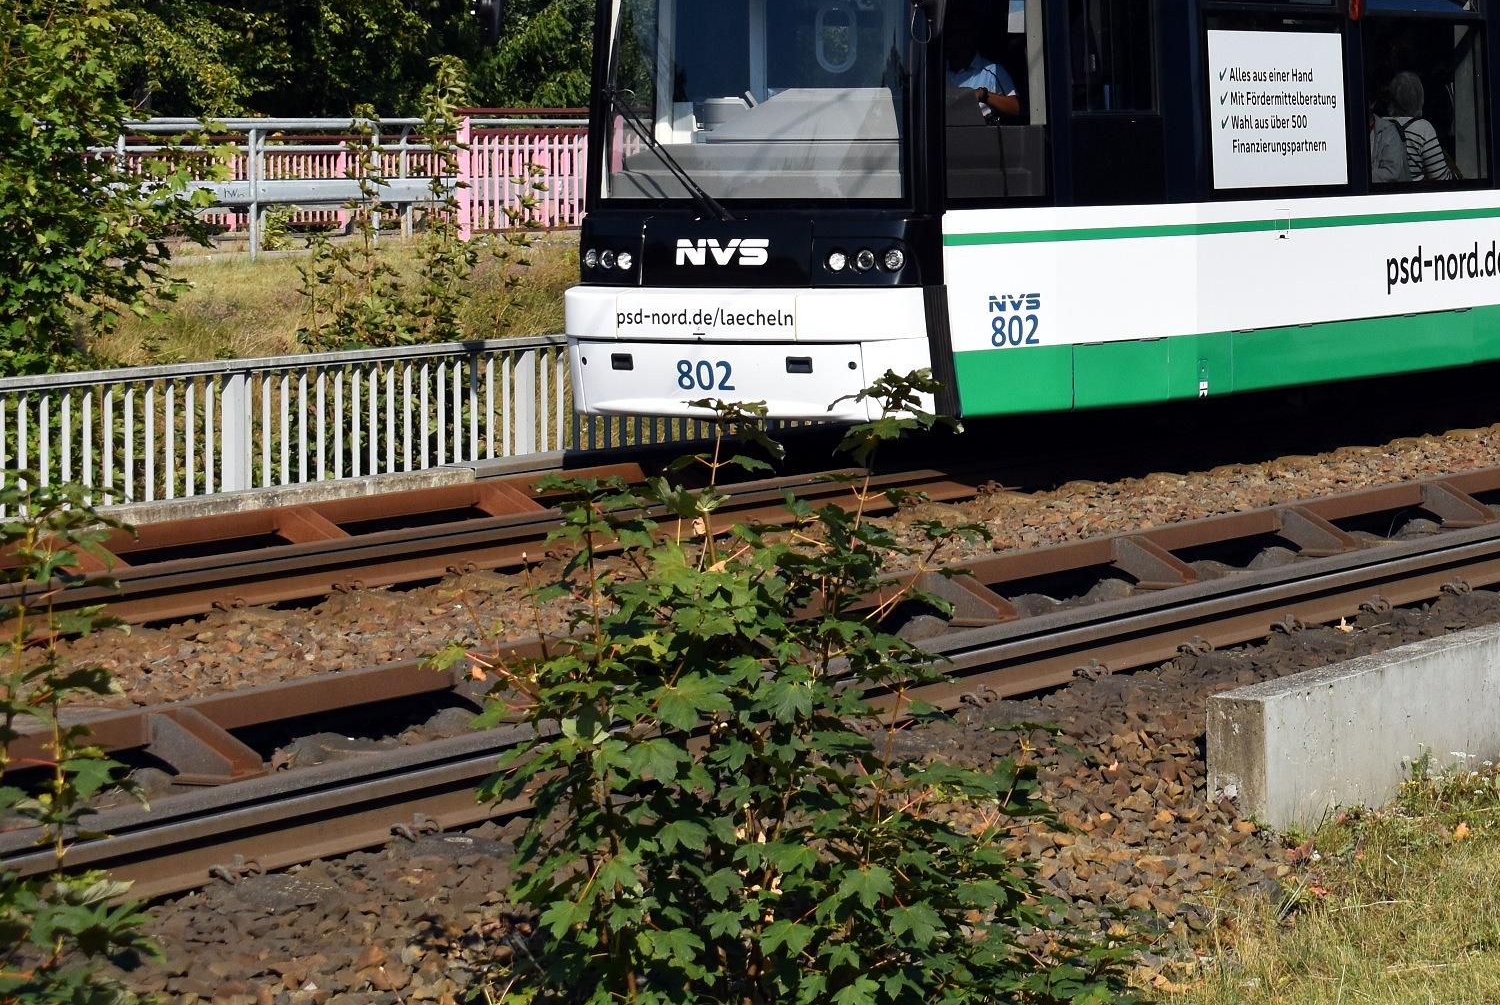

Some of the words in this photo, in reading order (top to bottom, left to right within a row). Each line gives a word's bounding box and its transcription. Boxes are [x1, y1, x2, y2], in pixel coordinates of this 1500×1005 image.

[1229, 68, 1251, 82] Alles
[1252, 72, 1267, 82] aus
[1268, 68, 1290, 82] einer
[1291, 68, 1314, 82] Hand
[1230, 92, 1245, 106] Mit
[1246, 91, 1337, 109] Fördermittelberatung
[1231, 115, 1253, 129] Wahl
[1254, 118, 1269, 129] aus
[1270, 115, 1290, 129] über
[1291, 114, 1308, 129] 500
[1232, 138, 1327, 156] Finanzierungspartnern
[676, 239, 769, 266] NVS
[988, 293, 1041, 313] NVS
[616, 308, 794, 328] psd-nord.de/laecheln
[991, 314, 1040, 347] 802
[676, 359, 736, 391] 802
